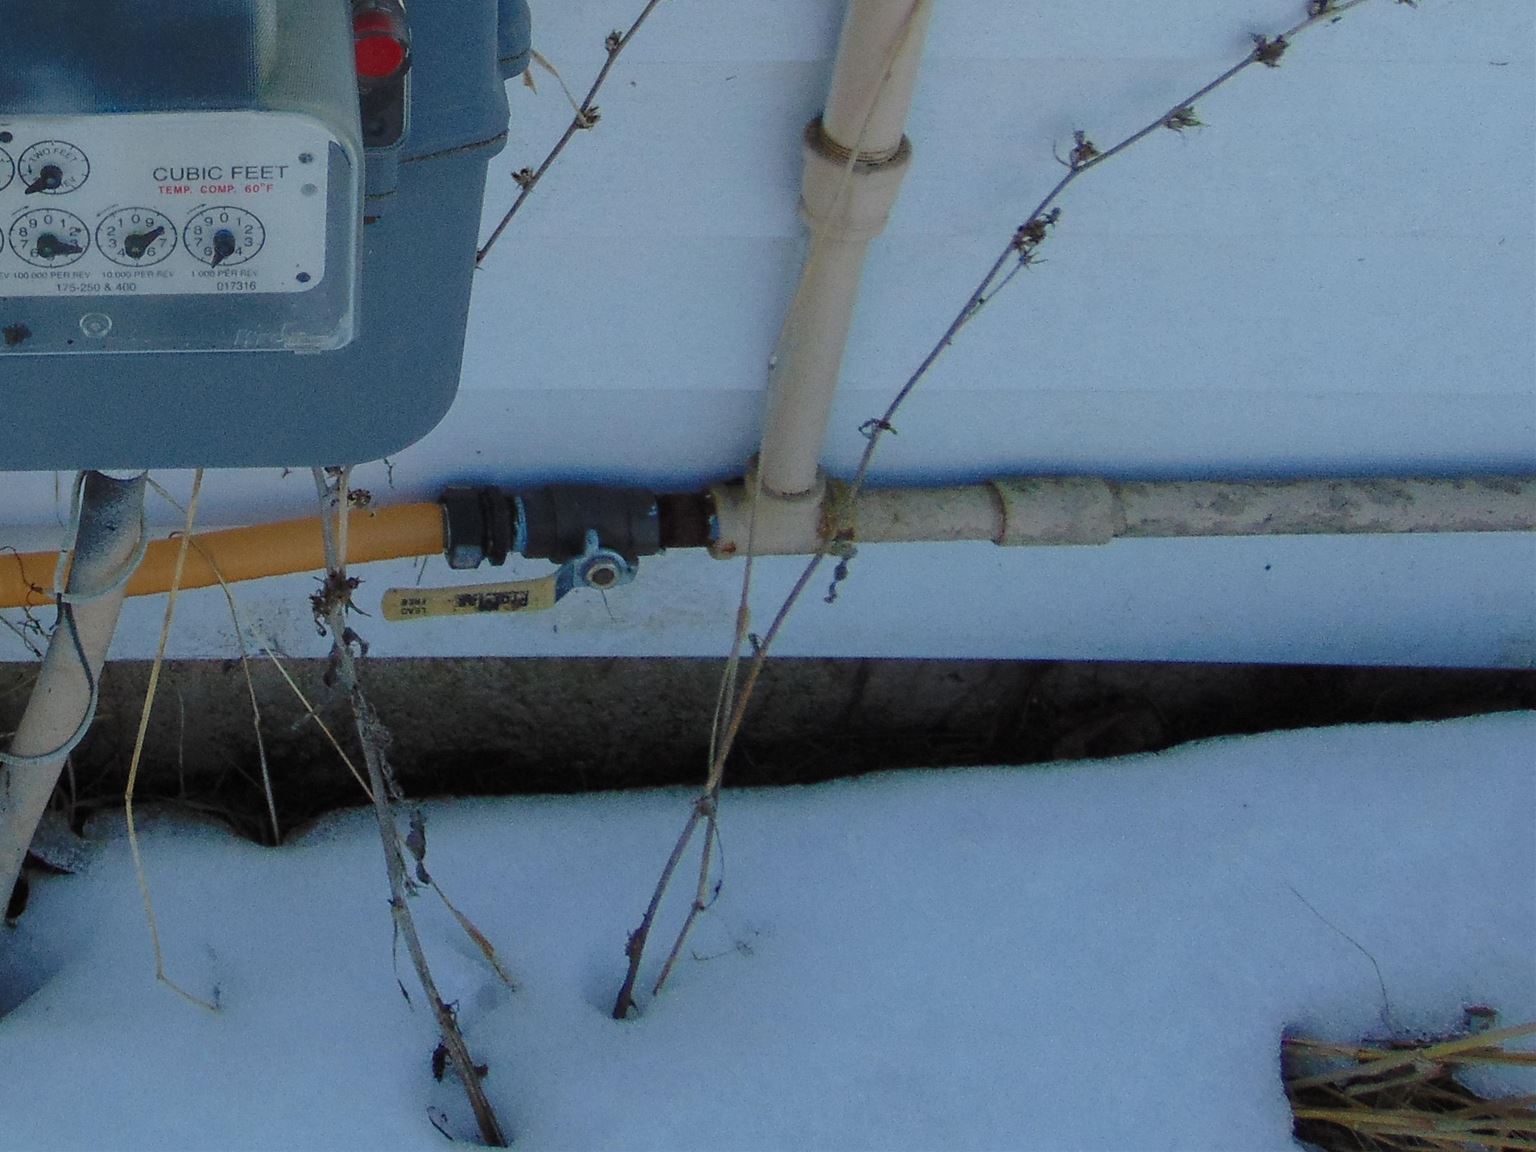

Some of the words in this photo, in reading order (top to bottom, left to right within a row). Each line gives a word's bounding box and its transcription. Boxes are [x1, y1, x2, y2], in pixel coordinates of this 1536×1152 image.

[152, 166, 223, 182] CUBIC
[231, 165, 289, 180] FEET
[158, 185, 192, 195] TEMP.
[200, 184, 236, 194] COMP.
[44, 215, 53, 224] 0
[131, 214, 140, 224] 0
[145, 218, 154, 227] 9
[204, 217, 213, 226] 9
[220, 213, 229, 223] 0
[29, 219, 37, 228] 9
[19, 227, 28, 237] 8
[69, 227, 77, 237] 2
[107, 226, 116, 236] 2
[194, 225, 202, 235] 8
[244, 225, 253, 234] 2
[21, 240, 29, 249] 7
[108, 238, 117, 248] 3
[159, 238, 167, 247] 7
[194, 237, 203, 247] 7
[244, 237, 253, 247] 3
[31, 248, 39, 258] 6
[117, 248, 126, 257] 4
[147, 247, 156, 257] 6
[204, 247, 212, 256] 6
[235, 247, 242, 256] 4
[50, 271, 70, 279] PER
[72, 271, 91, 279] REV
[134, 271, 154, 279] PER
[156, 270, 174, 278] REV
[217, 269, 238, 278] PER
[240, 269, 257, 277] REV
[57, 283, 101, 292] 175-250
[104, 282, 112, 291] &
[117, 282, 136, 291] 400
[217, 281, 256, 291] 017316
